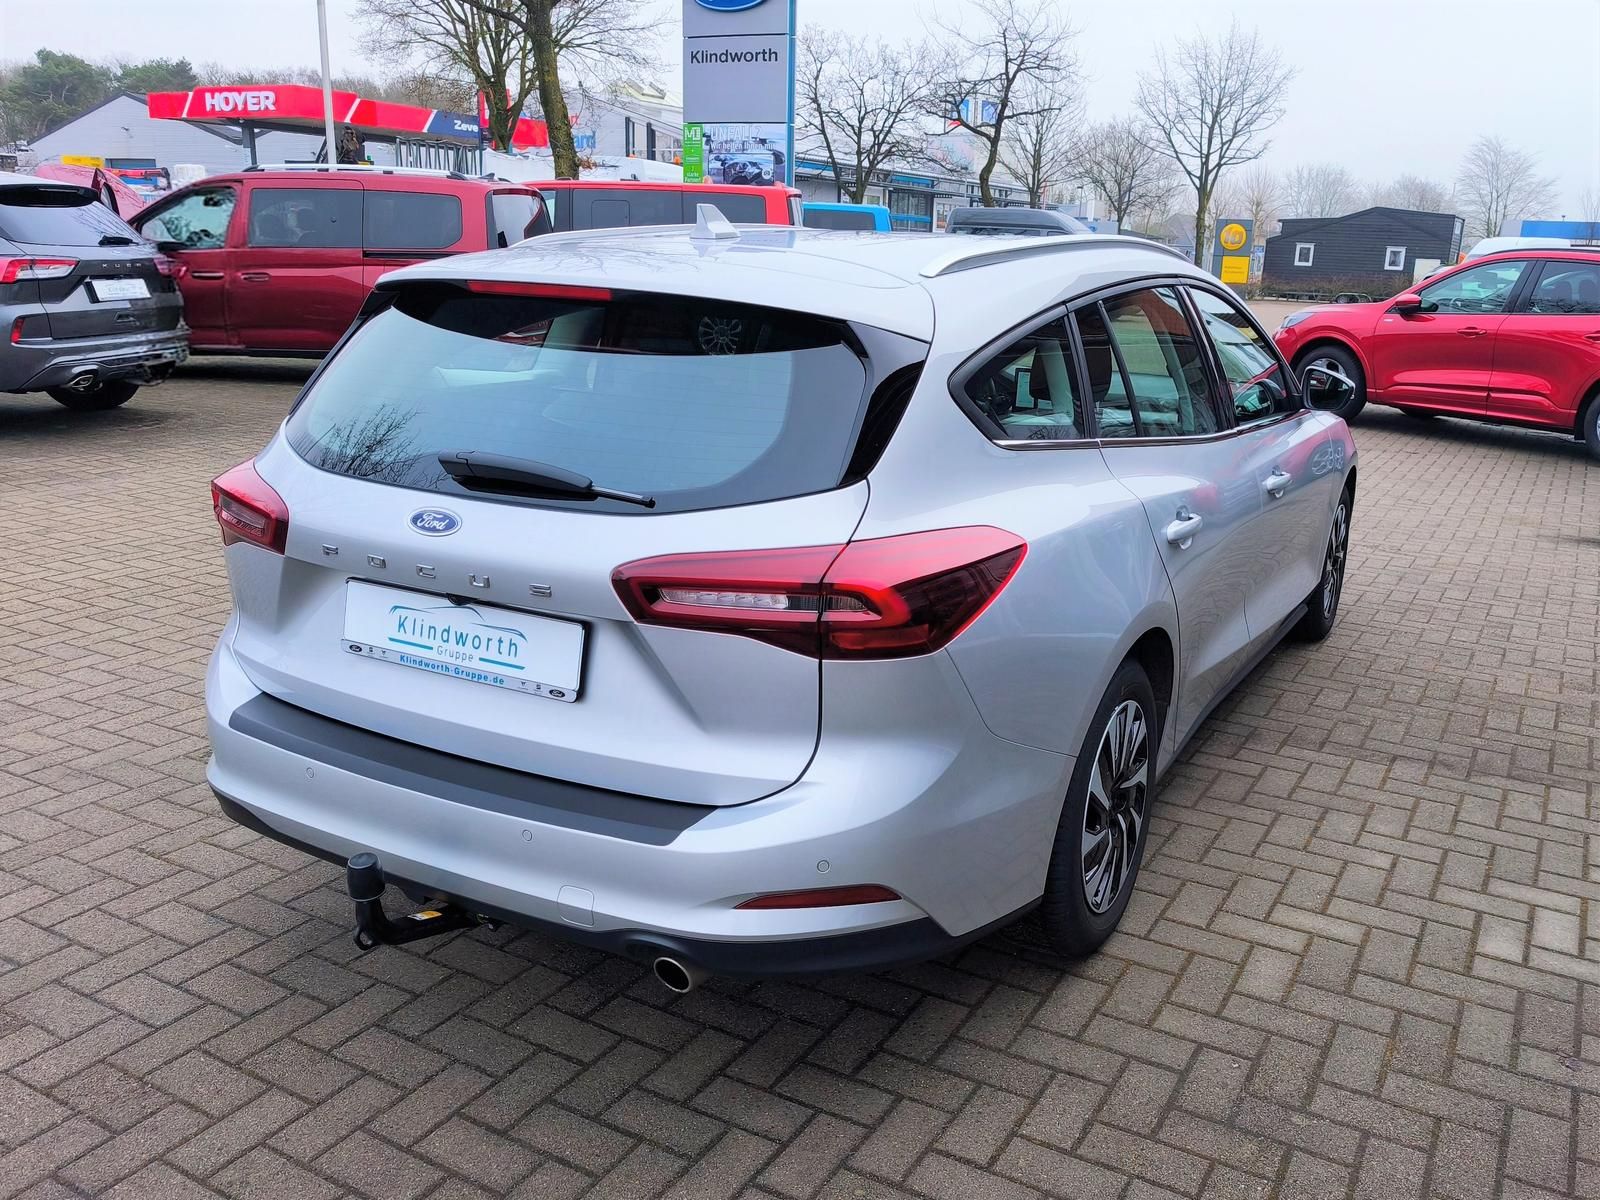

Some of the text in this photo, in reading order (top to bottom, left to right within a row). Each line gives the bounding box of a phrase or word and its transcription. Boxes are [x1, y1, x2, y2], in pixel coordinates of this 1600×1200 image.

[690, 48, 778, 64] Klindworth
[205, 91, 276, 112] HOYER
[416, 512, 450, 531] Ford
[322, 543, 552, 598] FOCUS
[398, 614, 518, 658] Klindworth
[436, 645, 474, 663] Gruppe
[400, 654, 505, 685] Klindworth-Gruppe.de
